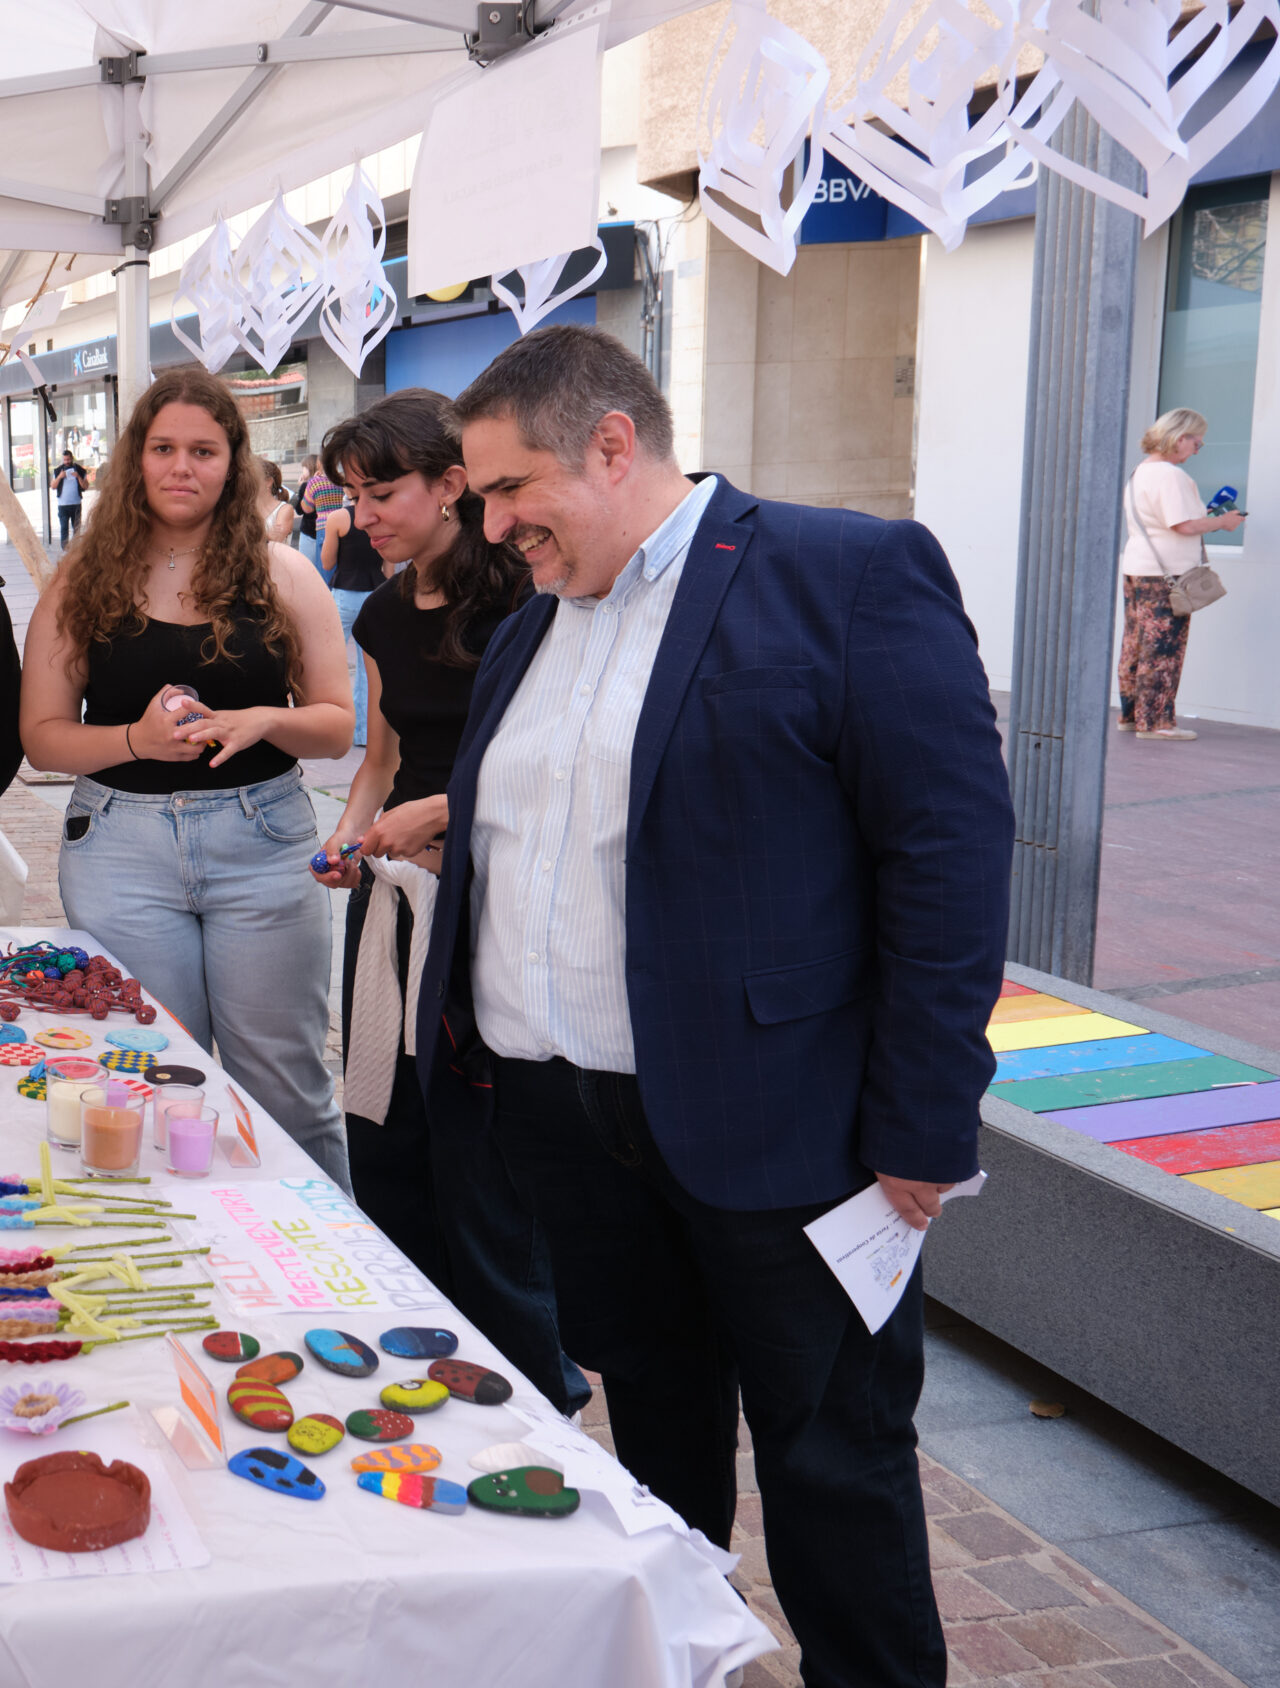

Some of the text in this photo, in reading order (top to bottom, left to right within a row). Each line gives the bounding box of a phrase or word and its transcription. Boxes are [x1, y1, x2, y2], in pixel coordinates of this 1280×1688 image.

[82, 347, 109, 368] CaixaBank
[207, 1253, 283, 1309] HELP
[211, 1188, 333, 1308] FUERTEVENTURA
[273, 1218, 378, 1306] RESCATE
